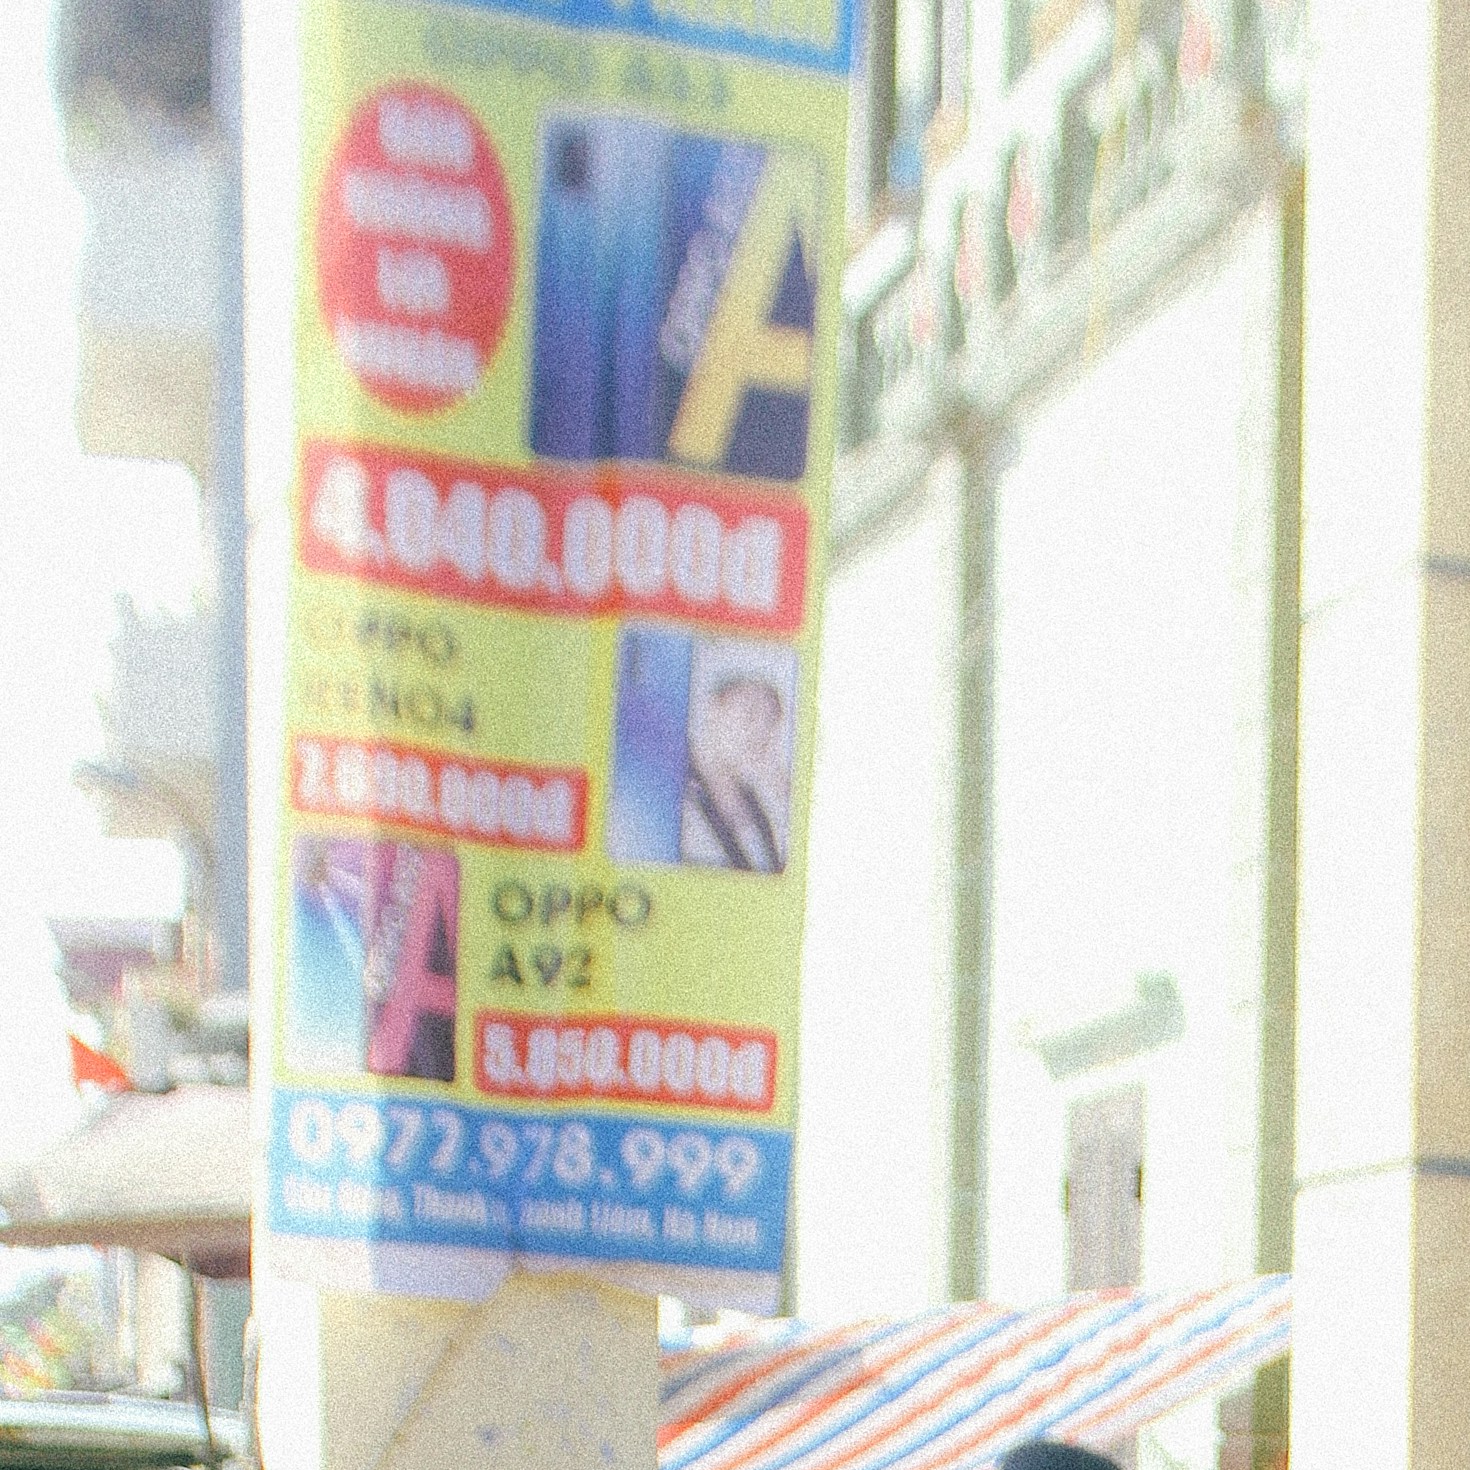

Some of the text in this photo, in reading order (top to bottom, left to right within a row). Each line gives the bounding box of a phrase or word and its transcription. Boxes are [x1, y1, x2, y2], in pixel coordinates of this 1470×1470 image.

[488, 878, 654, 931] OPPO
[486, 943, 597, 989] A92
[286, 1098, 761, 1197] 0977.978.999
